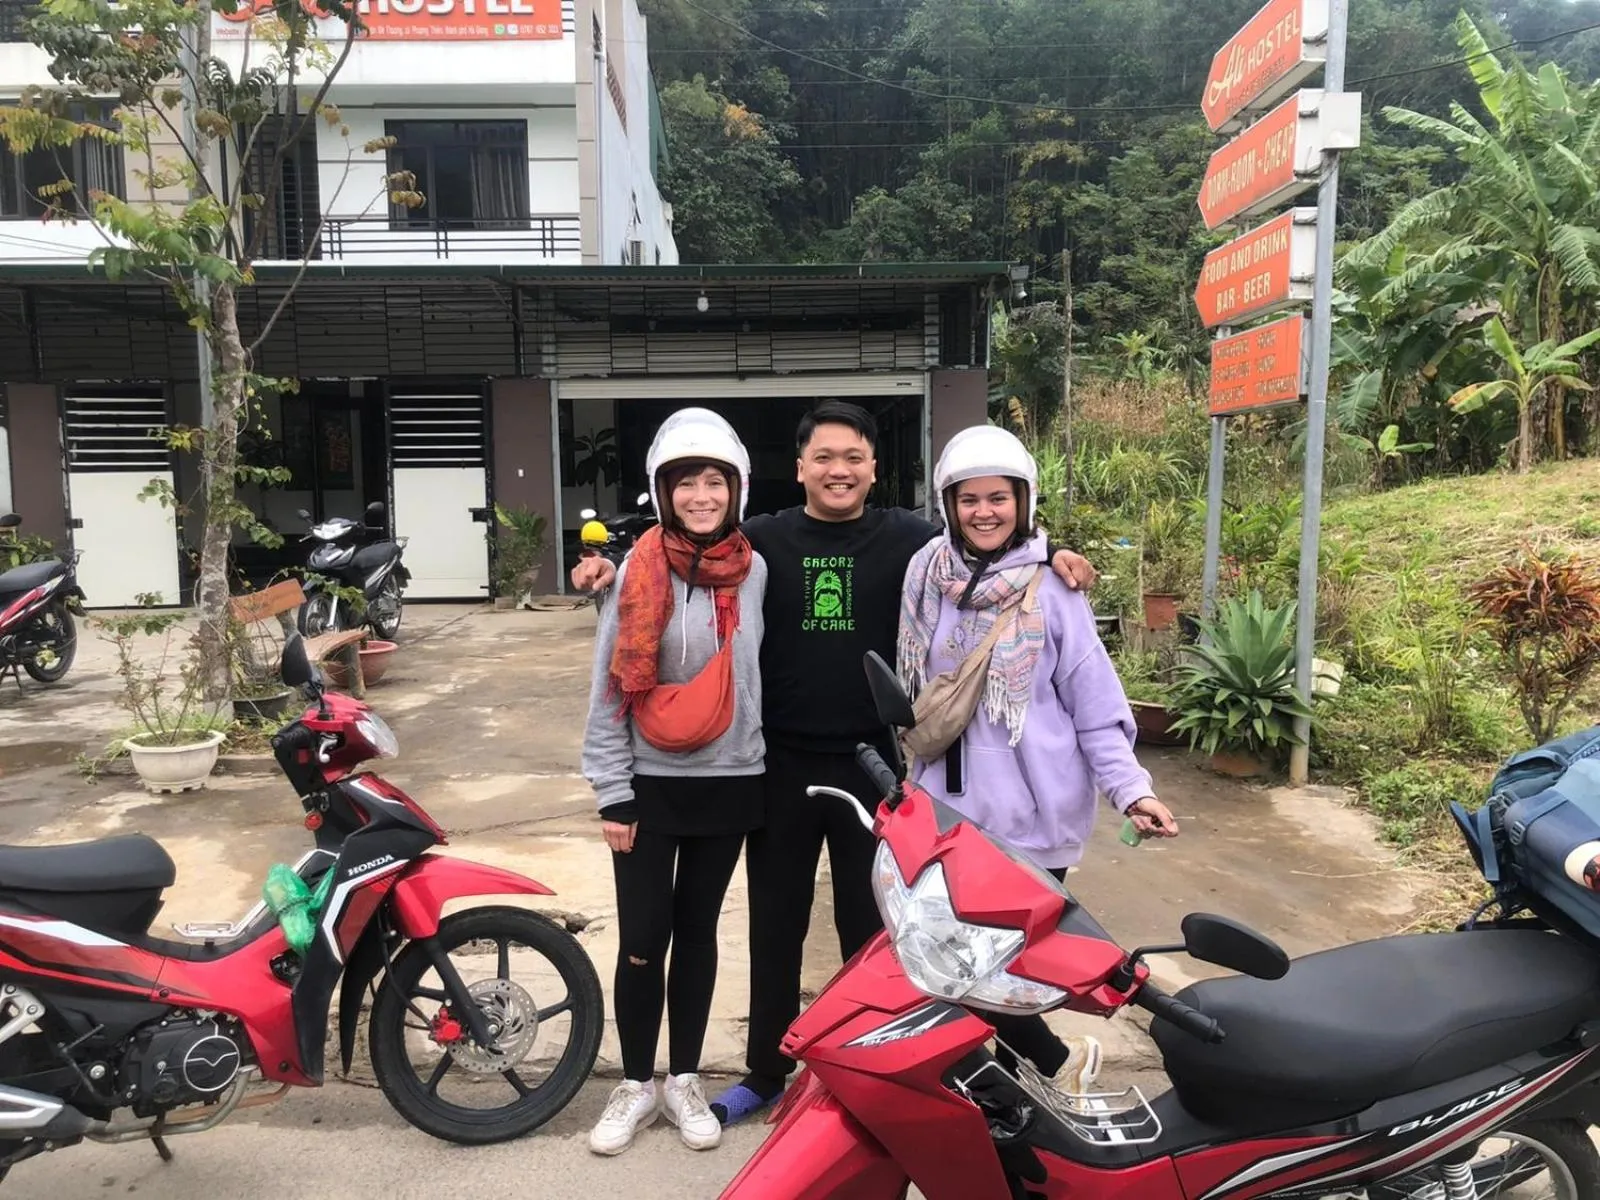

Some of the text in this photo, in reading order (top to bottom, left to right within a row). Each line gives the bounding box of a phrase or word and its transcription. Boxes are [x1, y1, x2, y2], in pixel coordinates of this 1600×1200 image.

[1247, 8, 1300, 74] HOSTEL
[1263, 121, 1296, 175] CHEAP
[1204, 225, 1288, 286] FOOD AND DRINK
[1216, 286, 1236, 314] BAR
[1243, 271, 1271, 304] BEER
[801, 619, 856, 631] OF CARE
[347, 854, 395, 876] HONDA
[1386, 1076, 1526, 1137] BLADE
